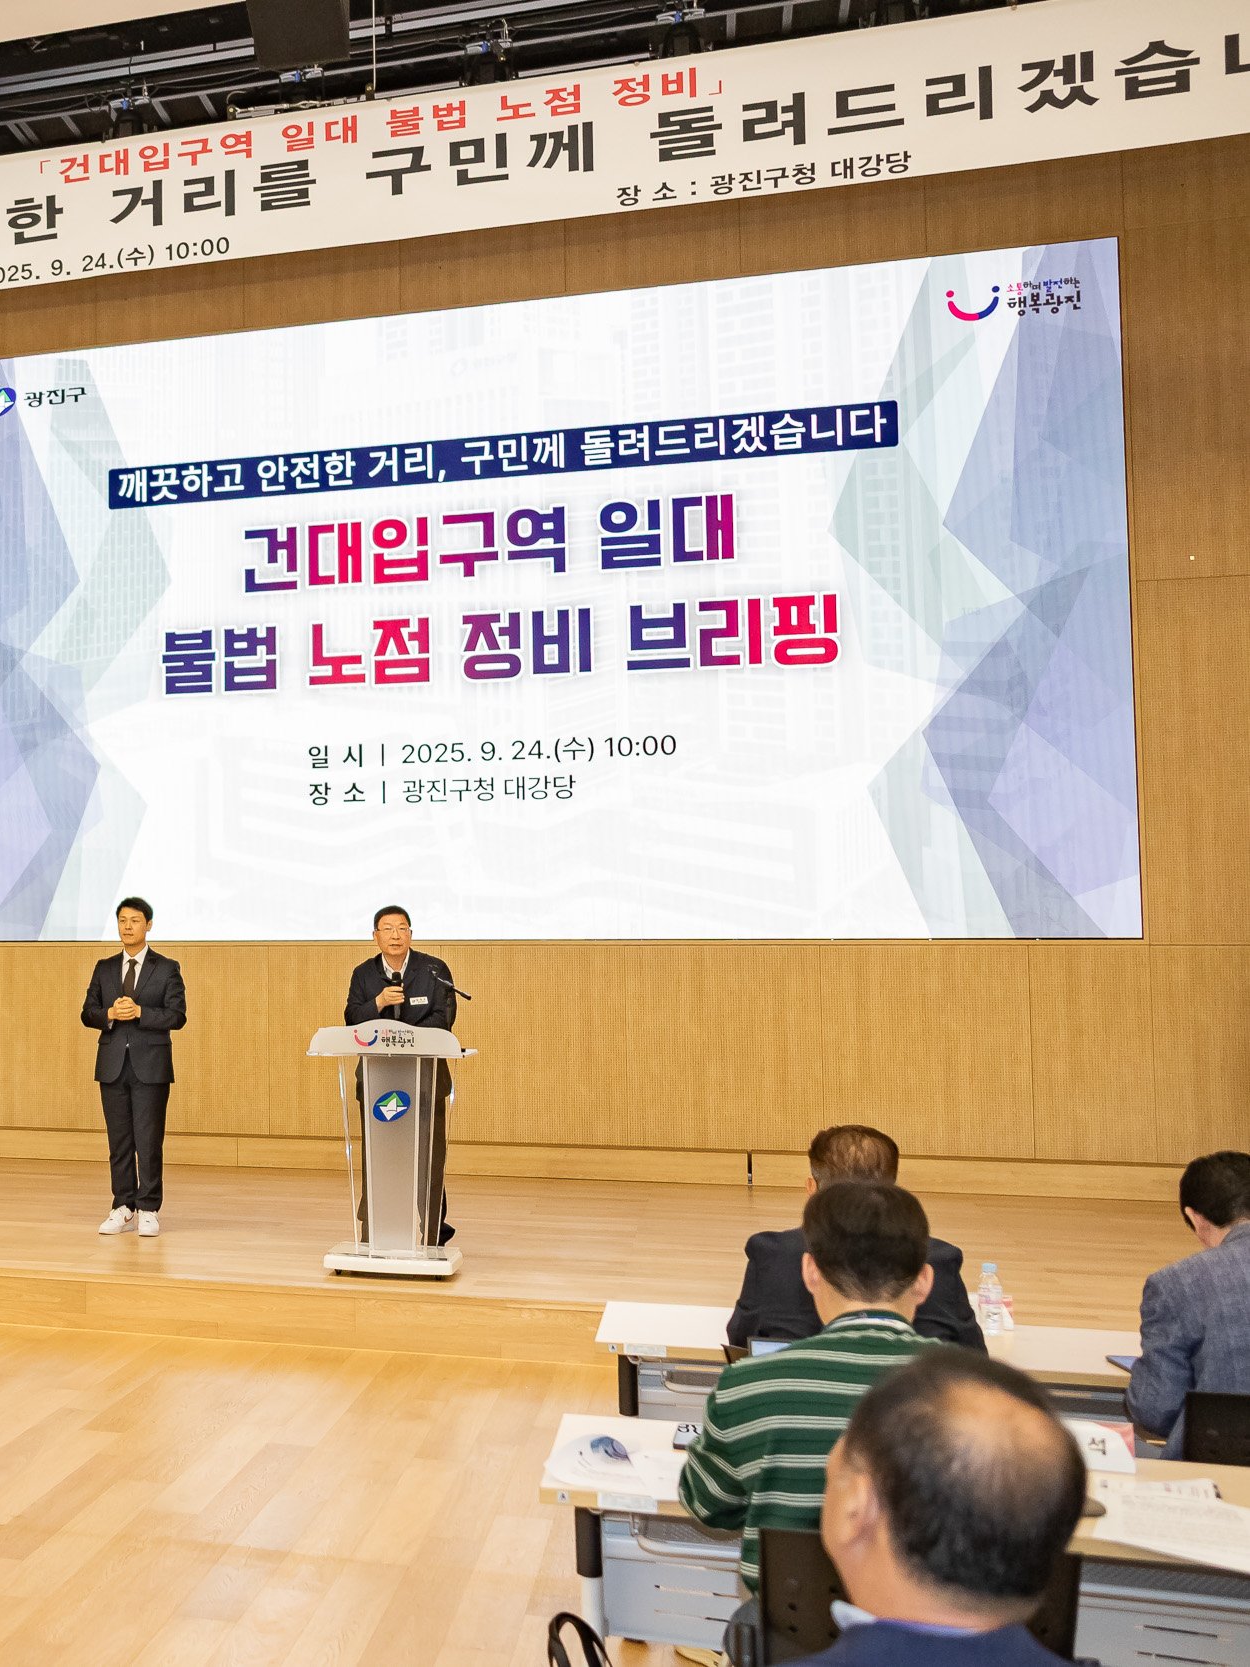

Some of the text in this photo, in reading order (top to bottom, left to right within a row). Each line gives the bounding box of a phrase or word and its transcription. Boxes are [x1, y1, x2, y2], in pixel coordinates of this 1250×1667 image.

[282, 113, 357, 152] 일대
[386, 101, 465, 137] 불법
[497, 84, 580, 121] 노점
[110, 159, 316, 226] 거리를
[366, 121, 593, 195] 구민께
[711, 163, 815, 195] 광진구청
[831, 151, 911, 179] 대강당
[166, 237, 230, 260] 10:00
[1007, 290, 1081, 316] 행복광진
[24, 387, 87, 407] 광진구
[119, 406, 886, 502] 깨끗하고 안전한 거리, 구민께 돌려드리겠습니다
[245, 494, 734, 592] 건대입구역 일대
[163, 594, 838, 694] 불법 노점 정비 브리핑
[402, 743, 471, 763] 2025.
[605, 735, 677, 757] 10:00
[402, 777, 495, 803] 광진구청
[504, 775, 576, 800] 대강당
